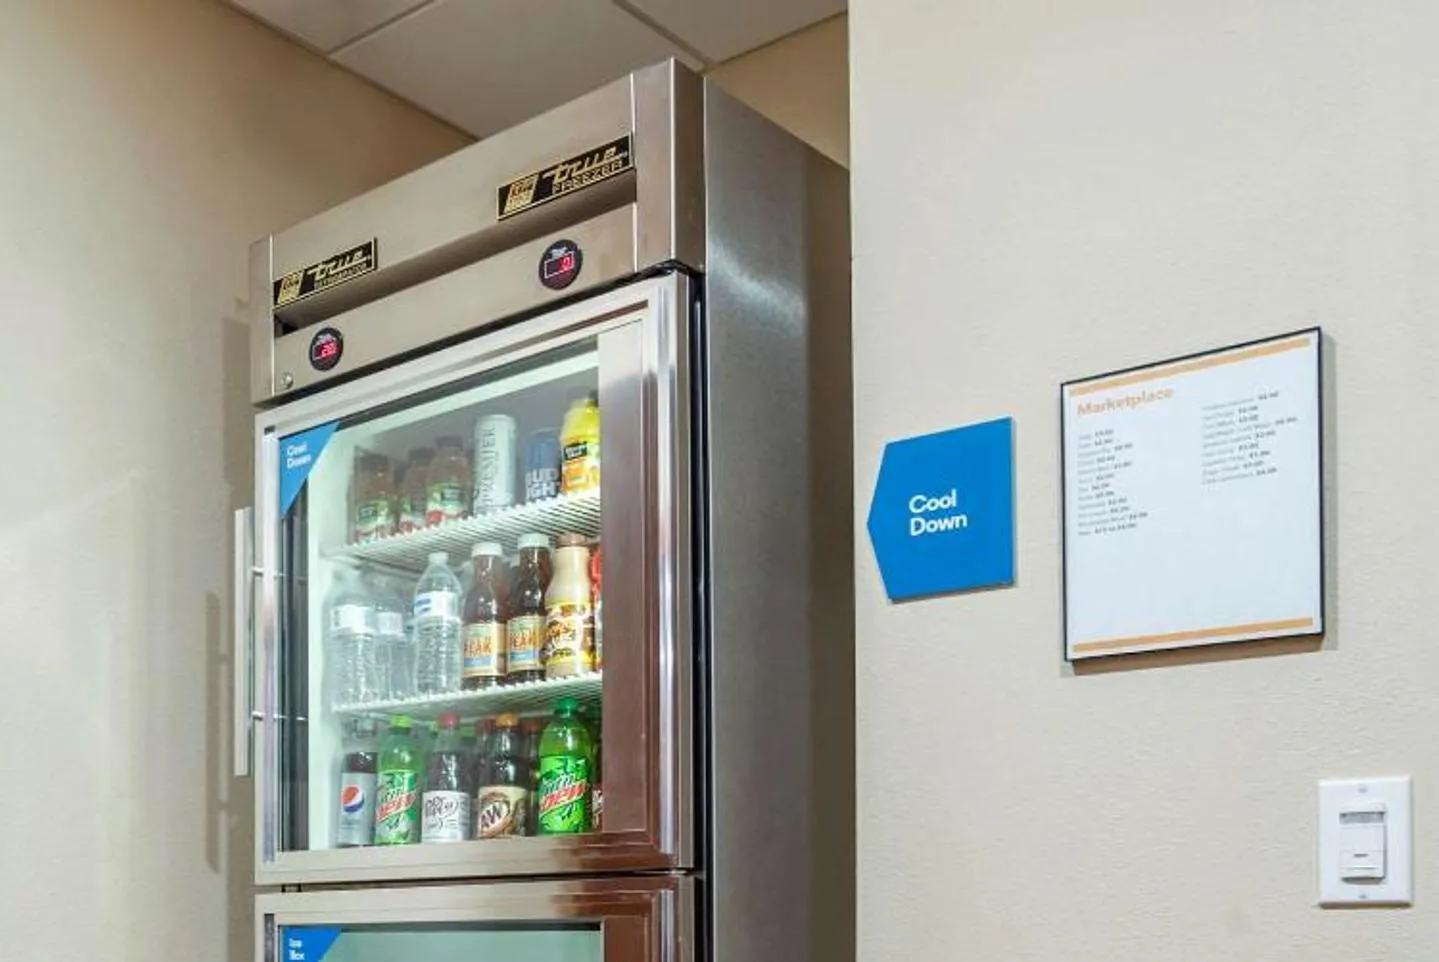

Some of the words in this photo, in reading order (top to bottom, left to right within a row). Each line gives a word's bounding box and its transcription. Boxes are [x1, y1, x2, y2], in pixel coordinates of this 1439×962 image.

[1077, 387, 1174, 416] Marketplace
[909, 488, 956, 513] Cool
[910, 514, 968, 536] Down
